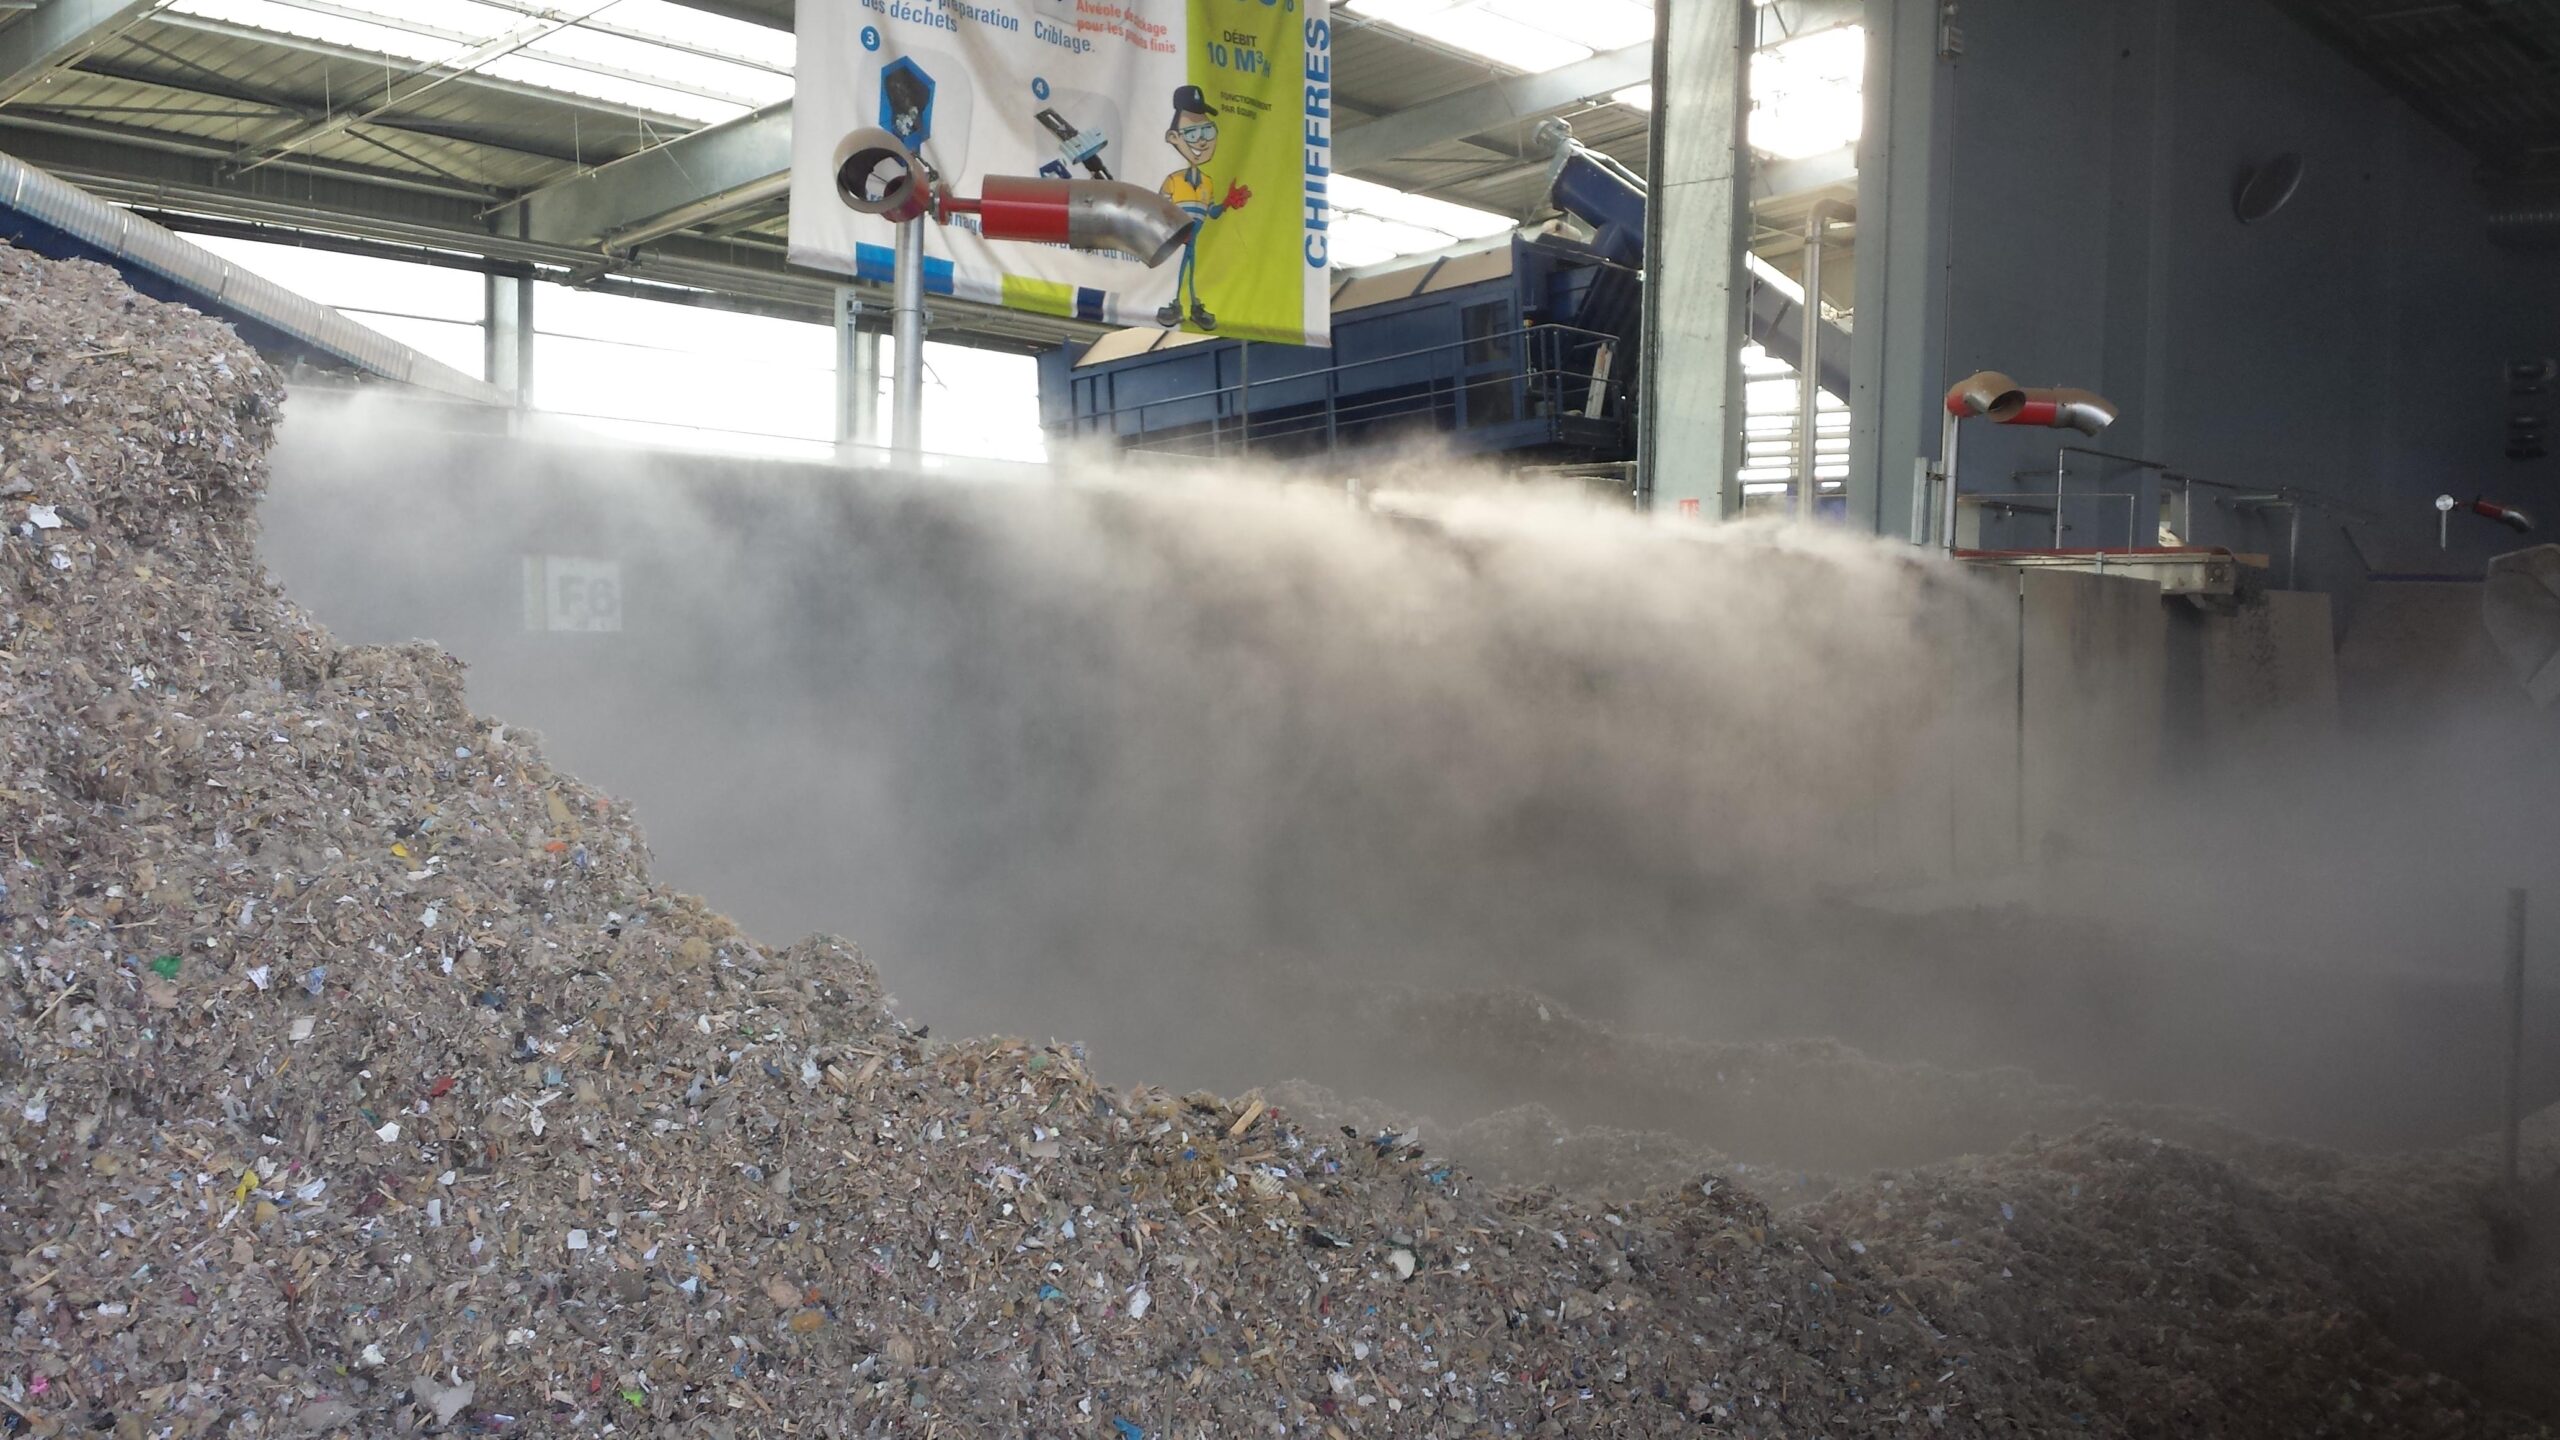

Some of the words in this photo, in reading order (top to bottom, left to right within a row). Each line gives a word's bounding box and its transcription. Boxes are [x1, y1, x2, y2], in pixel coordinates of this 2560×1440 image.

[890, 0, 958, 32] déchets
[1034, 20, 1096, 54] Criblage.
[1076, 19, 1104, 32] pour
[1107, 21, 1124, 36] les
[1150, 39, 1176, 53] finis
[1223, 29, 1257, 47] DÉBIT
[1207, 41, 1228, 68] 10
[1305, 17, 1330, 268] CHIFFRES
[558, 575, 617, 617] F6
